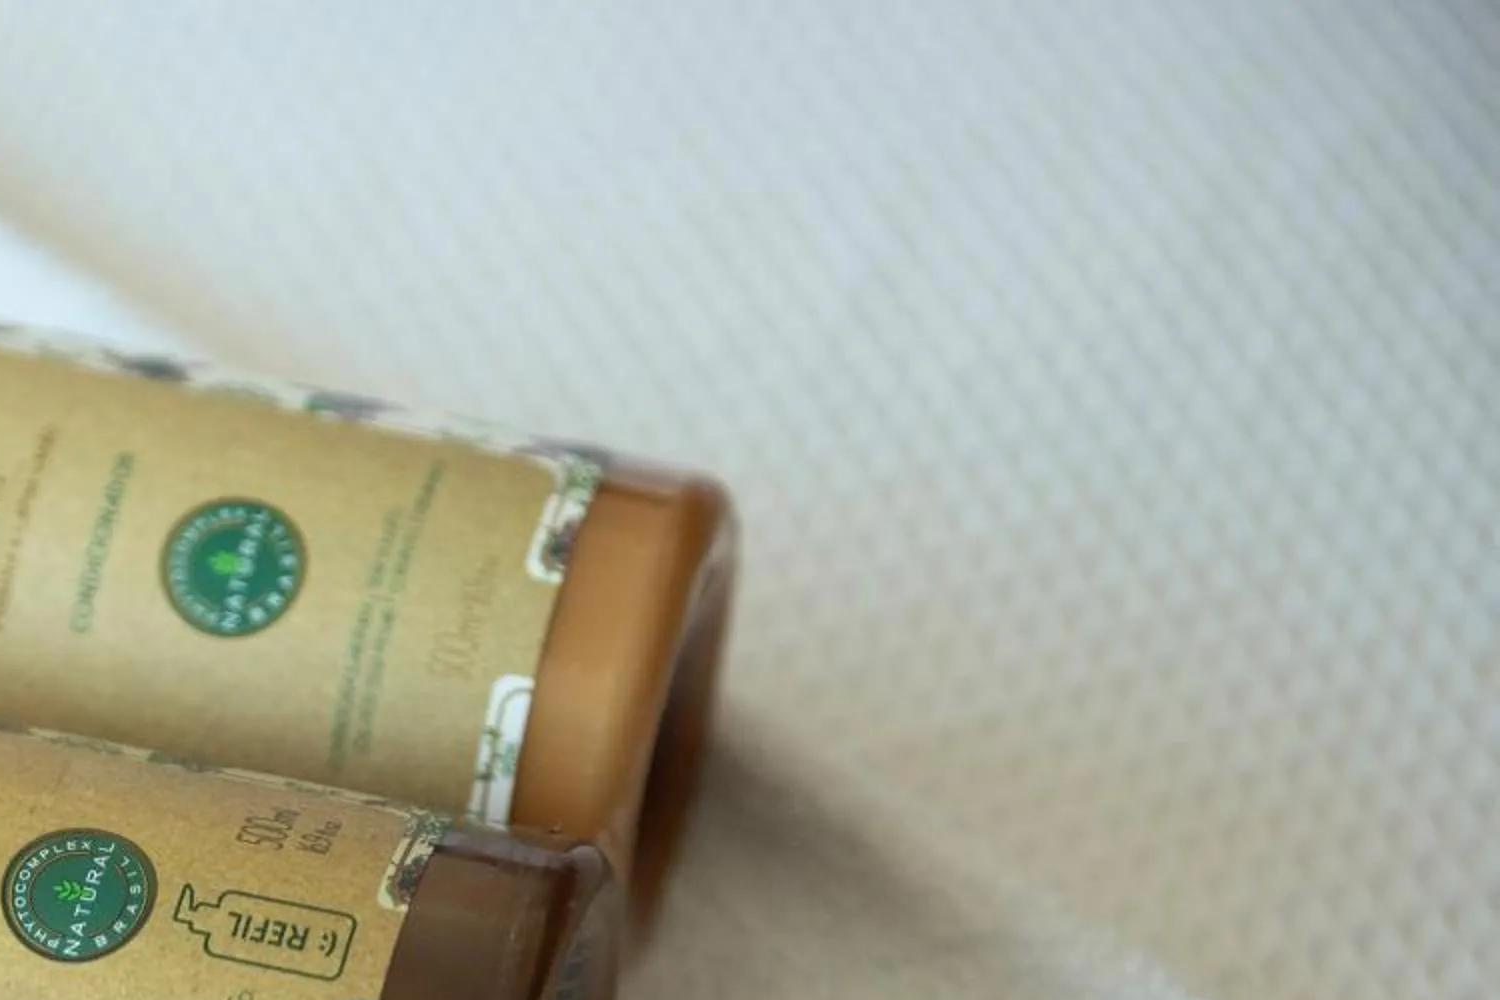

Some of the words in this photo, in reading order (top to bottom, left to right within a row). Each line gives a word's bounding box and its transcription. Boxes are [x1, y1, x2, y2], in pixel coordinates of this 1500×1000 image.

[220, 510, 272, 632] NATURAL
[15, 839, 93, 950] PHYTOCOMPLEX
[62, 841, 115, 957] NATURAL
[93, 855, 141, 948] BRASIL
[228, 911, 310, 951] REFIL
